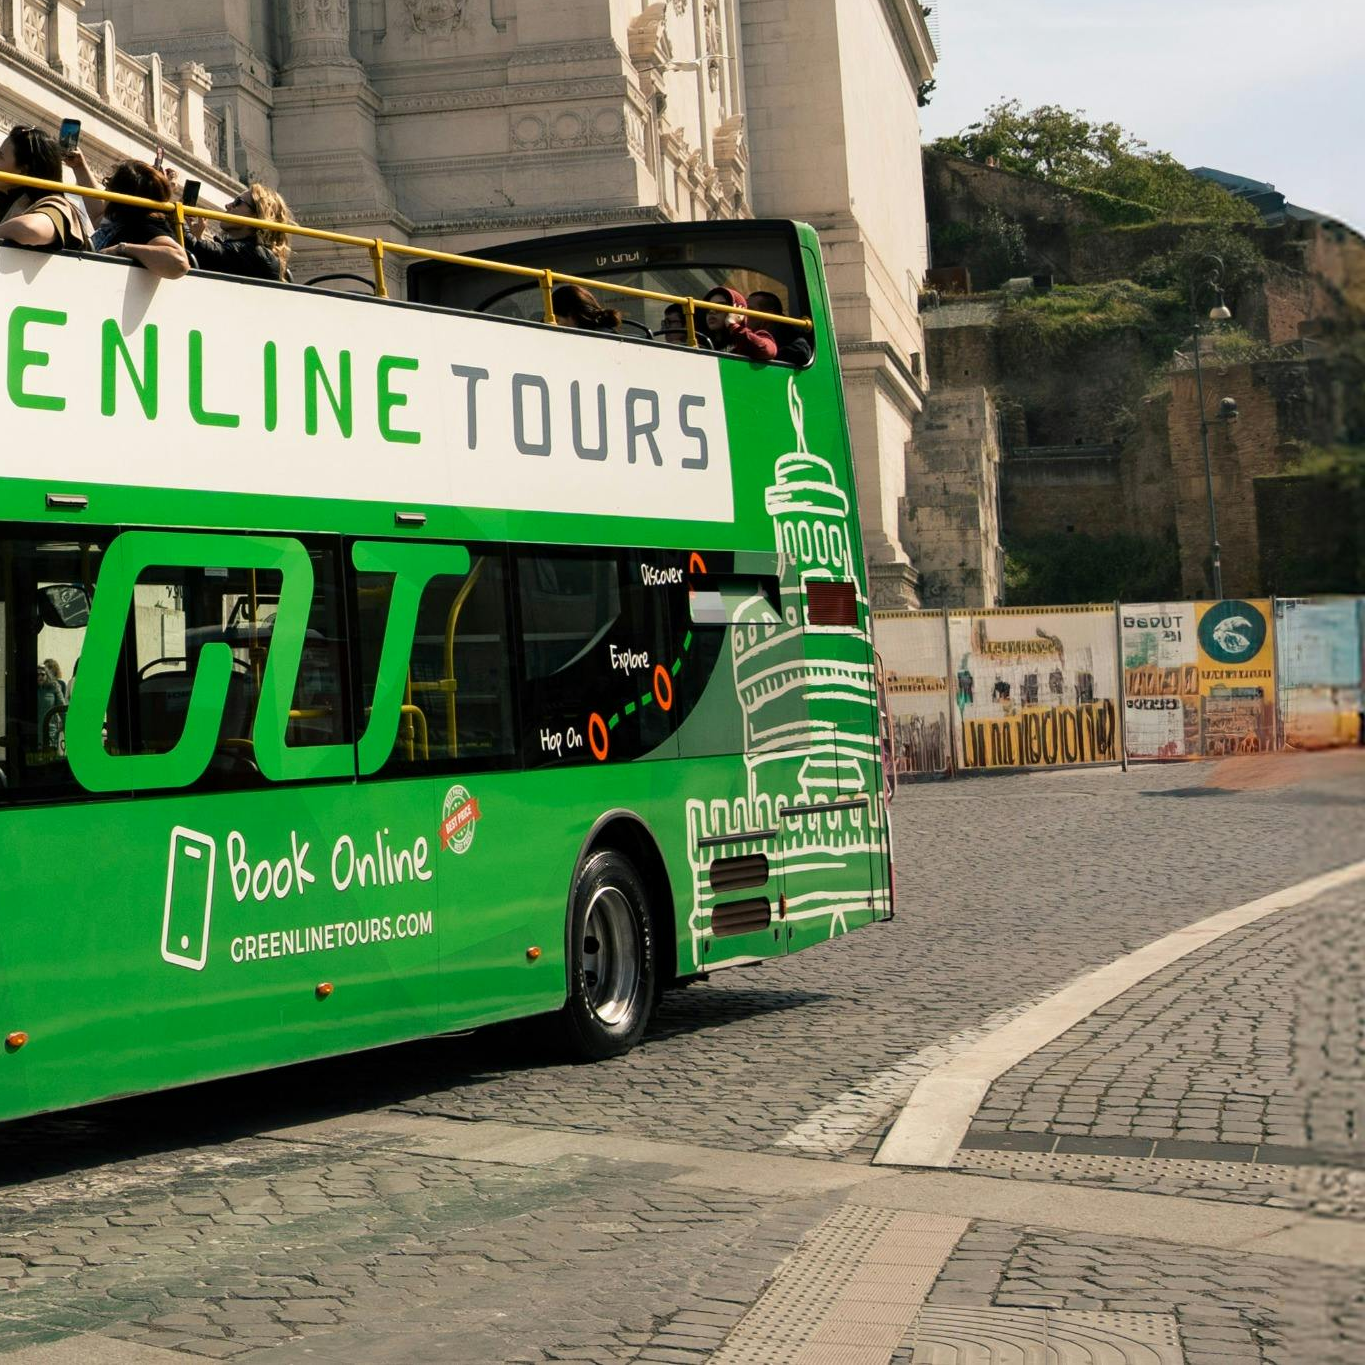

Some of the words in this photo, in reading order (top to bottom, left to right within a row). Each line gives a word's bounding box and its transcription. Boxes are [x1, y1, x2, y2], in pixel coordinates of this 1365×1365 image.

[450, 363, 709, 471] TOURS
[641, 563, 684, 586] Discover
[610, 645, 651, 676] Explore
[540, 728, 561, 757] Hop
[566, 727, 583, 748] On
[446, 816, 458, 834] BEST
[227, 830, 316, 902] Book
[331, 827, 433, 892] Online
[230, 910, 433, 963] GREENLINETOURS.COM
